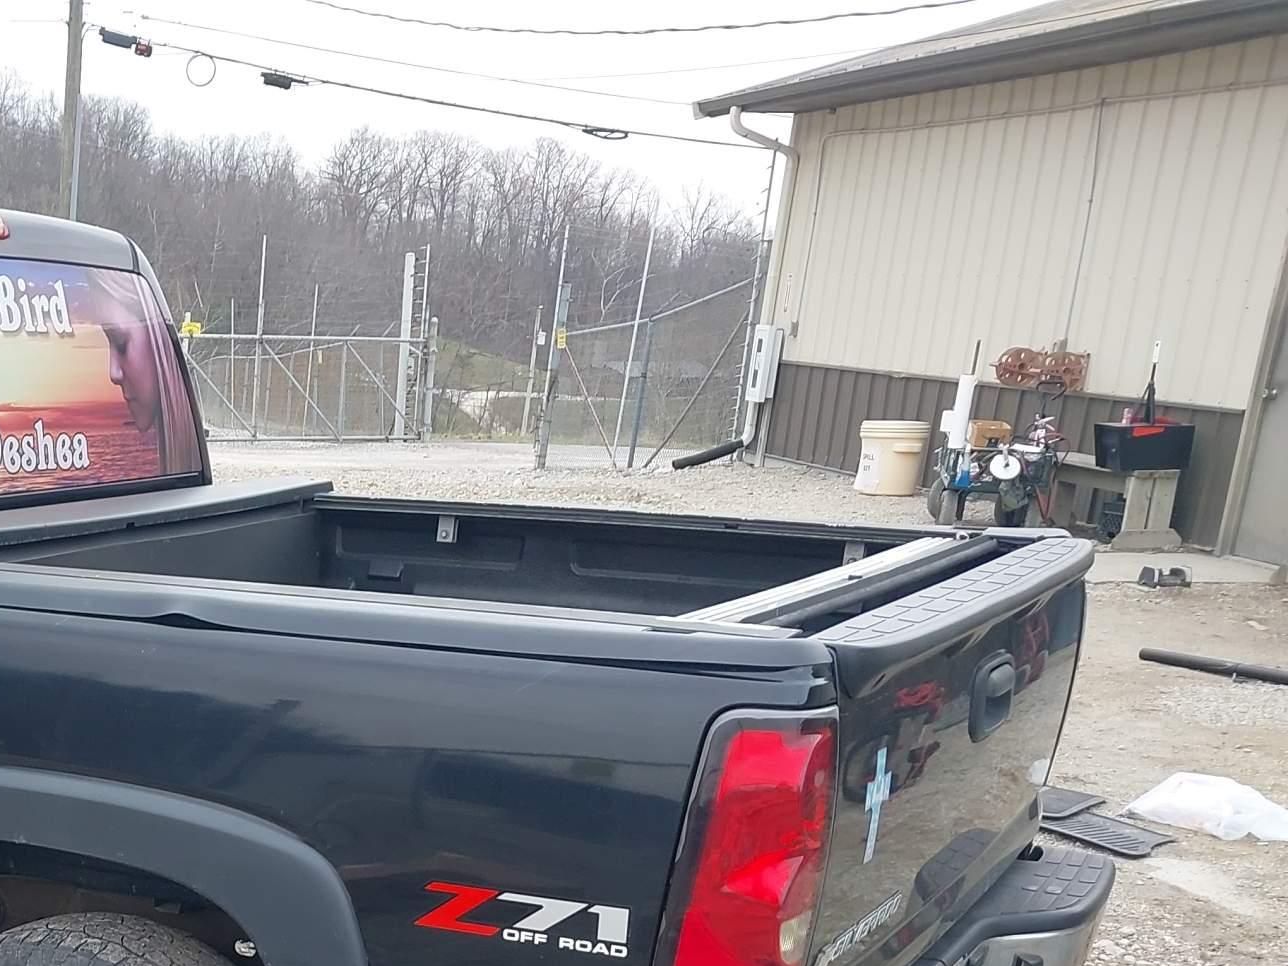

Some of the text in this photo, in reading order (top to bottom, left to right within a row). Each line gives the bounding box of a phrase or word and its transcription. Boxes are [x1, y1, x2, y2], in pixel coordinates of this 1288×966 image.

[414, 881, 630, 938] Z71
[502, 928, 628, 958] OFF ROAD
